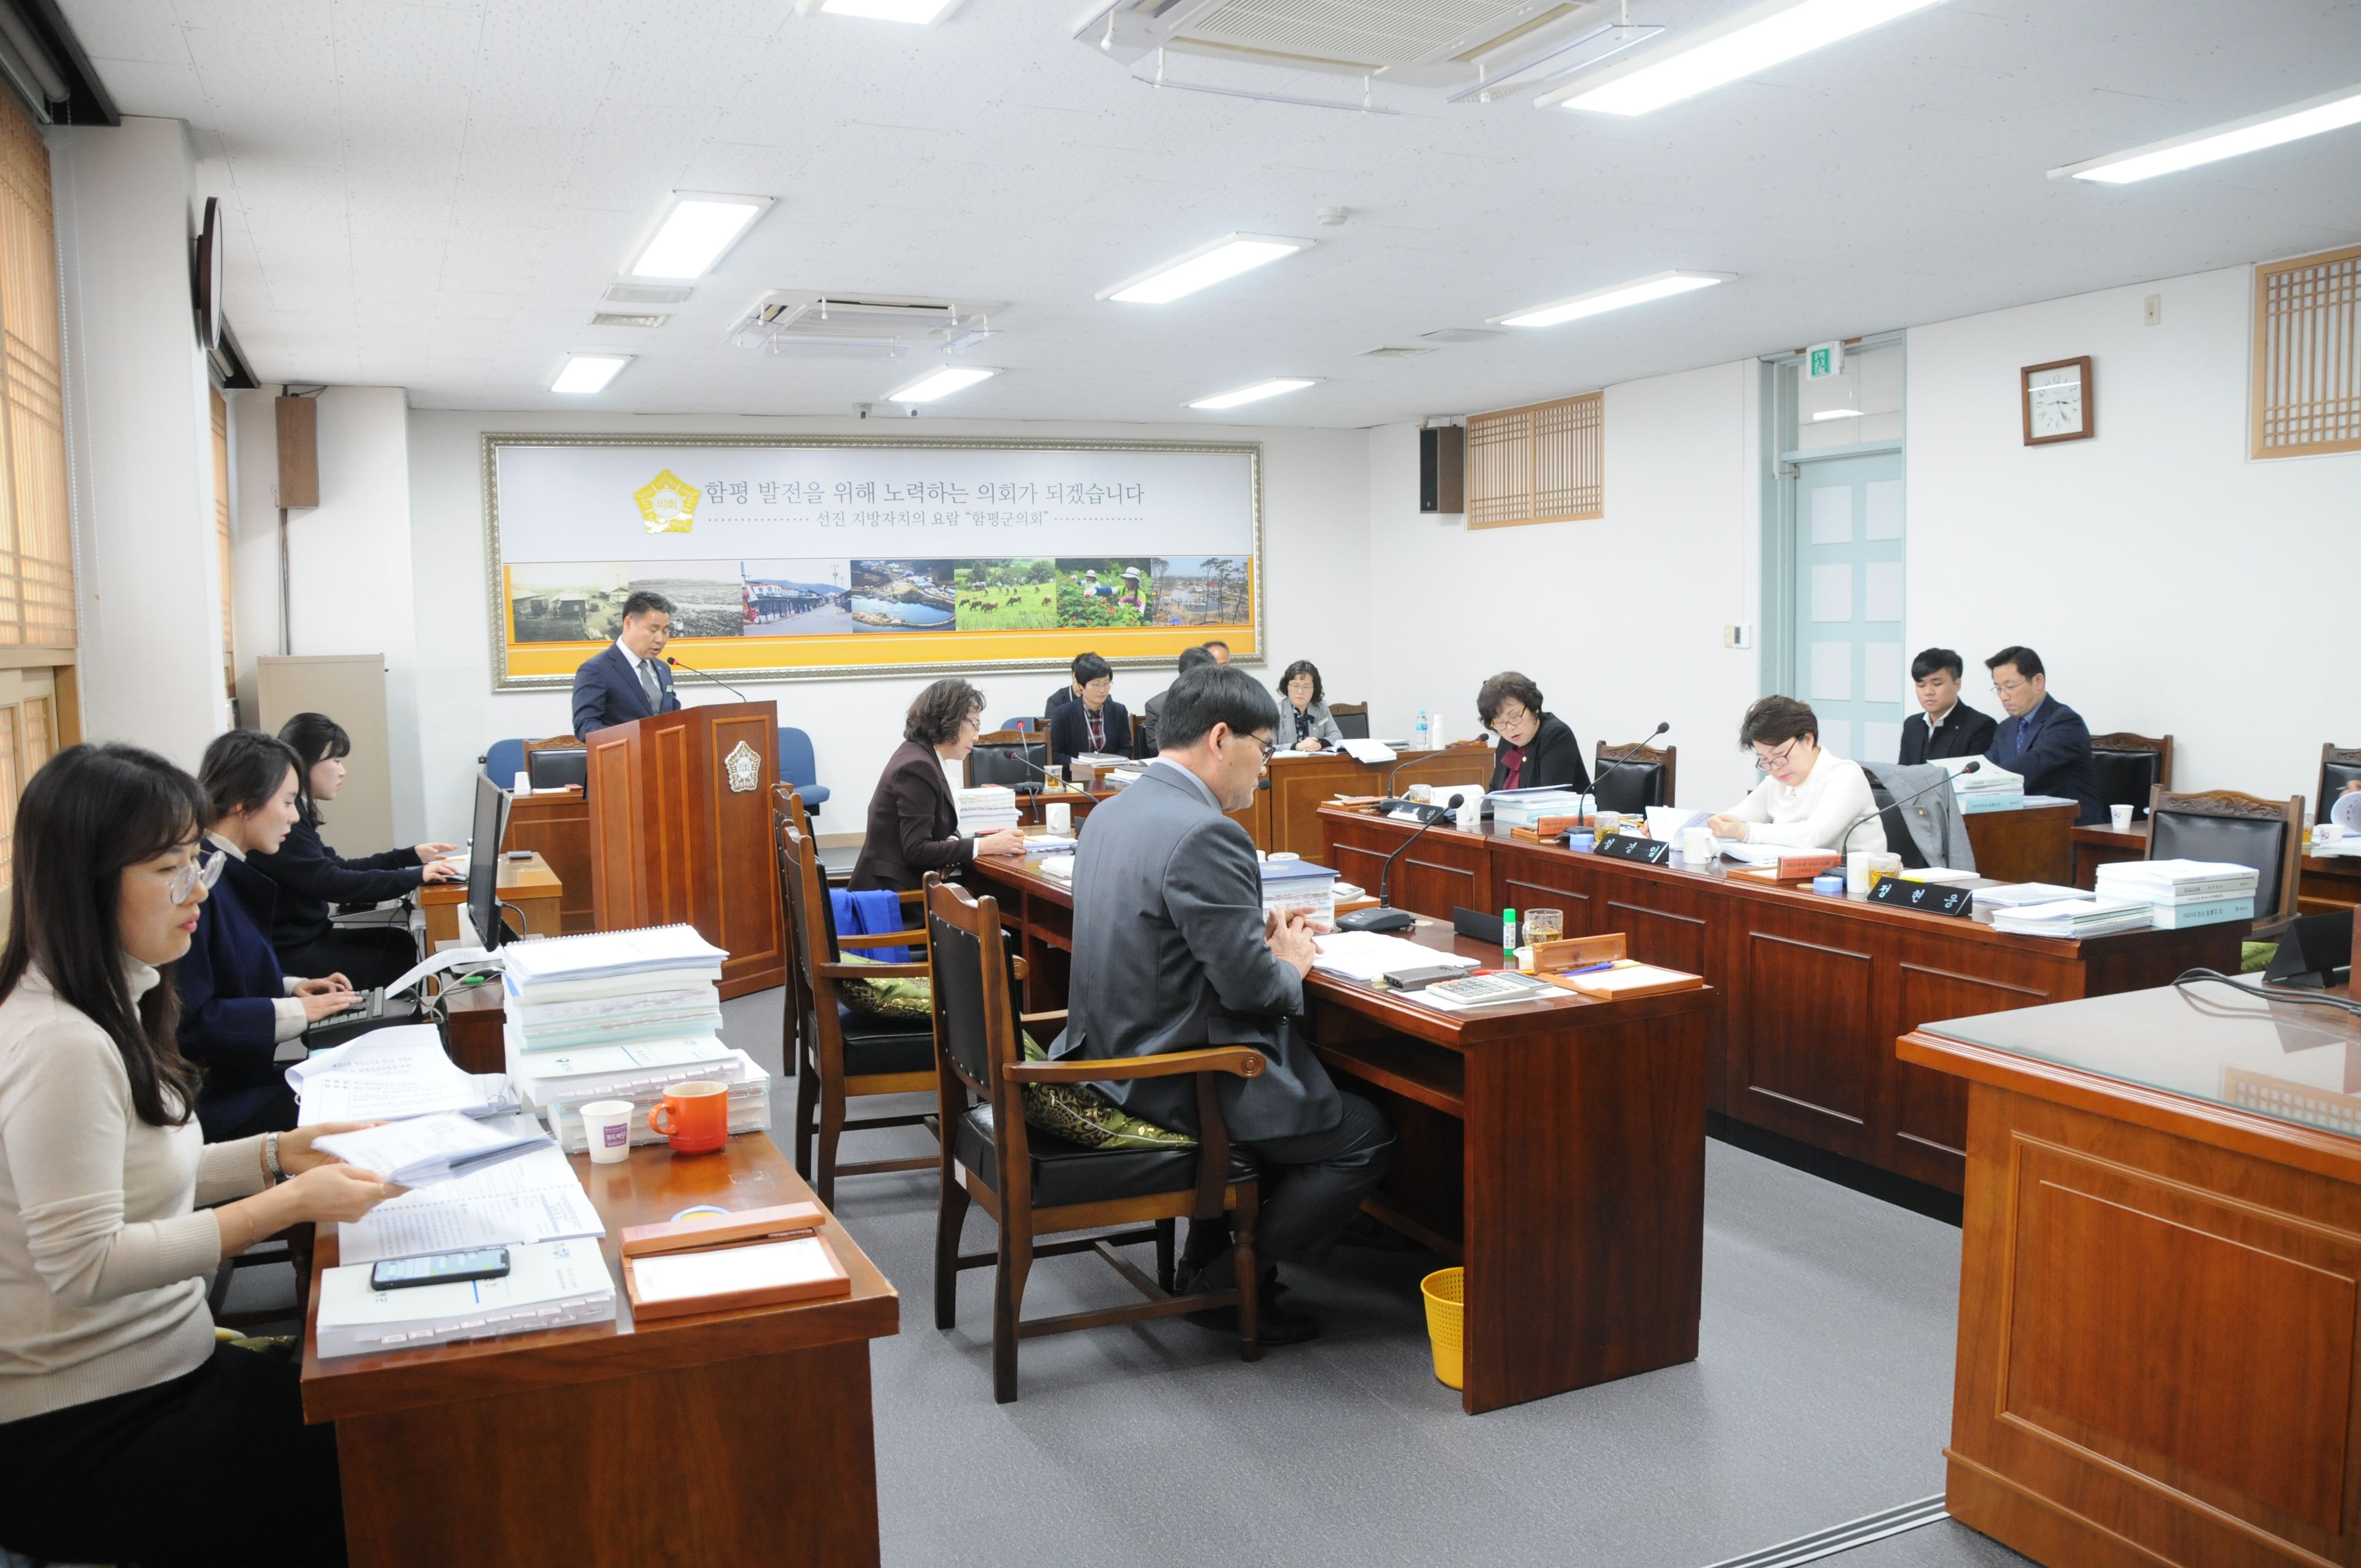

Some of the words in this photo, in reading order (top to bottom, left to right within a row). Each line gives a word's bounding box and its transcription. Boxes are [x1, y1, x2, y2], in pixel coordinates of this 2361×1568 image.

[705, 481, 747, 504] 함평
[758, 481, 825, 504] 발전을
[834, 481, 874, 504] 위해
[884, 482, 969, 504] 노력하는
[977, 483, 1038, 504] 의회가
[1046, 483, 1144, 505] 되겠습니다
[656, 498, 678, 510] 의회
[817, 511, 845, 526] 선진
[852, 511, 924, 527] 지방자치의
[932, 511, 960, 526] 요람
[738, 761, 749, 773] 의회
